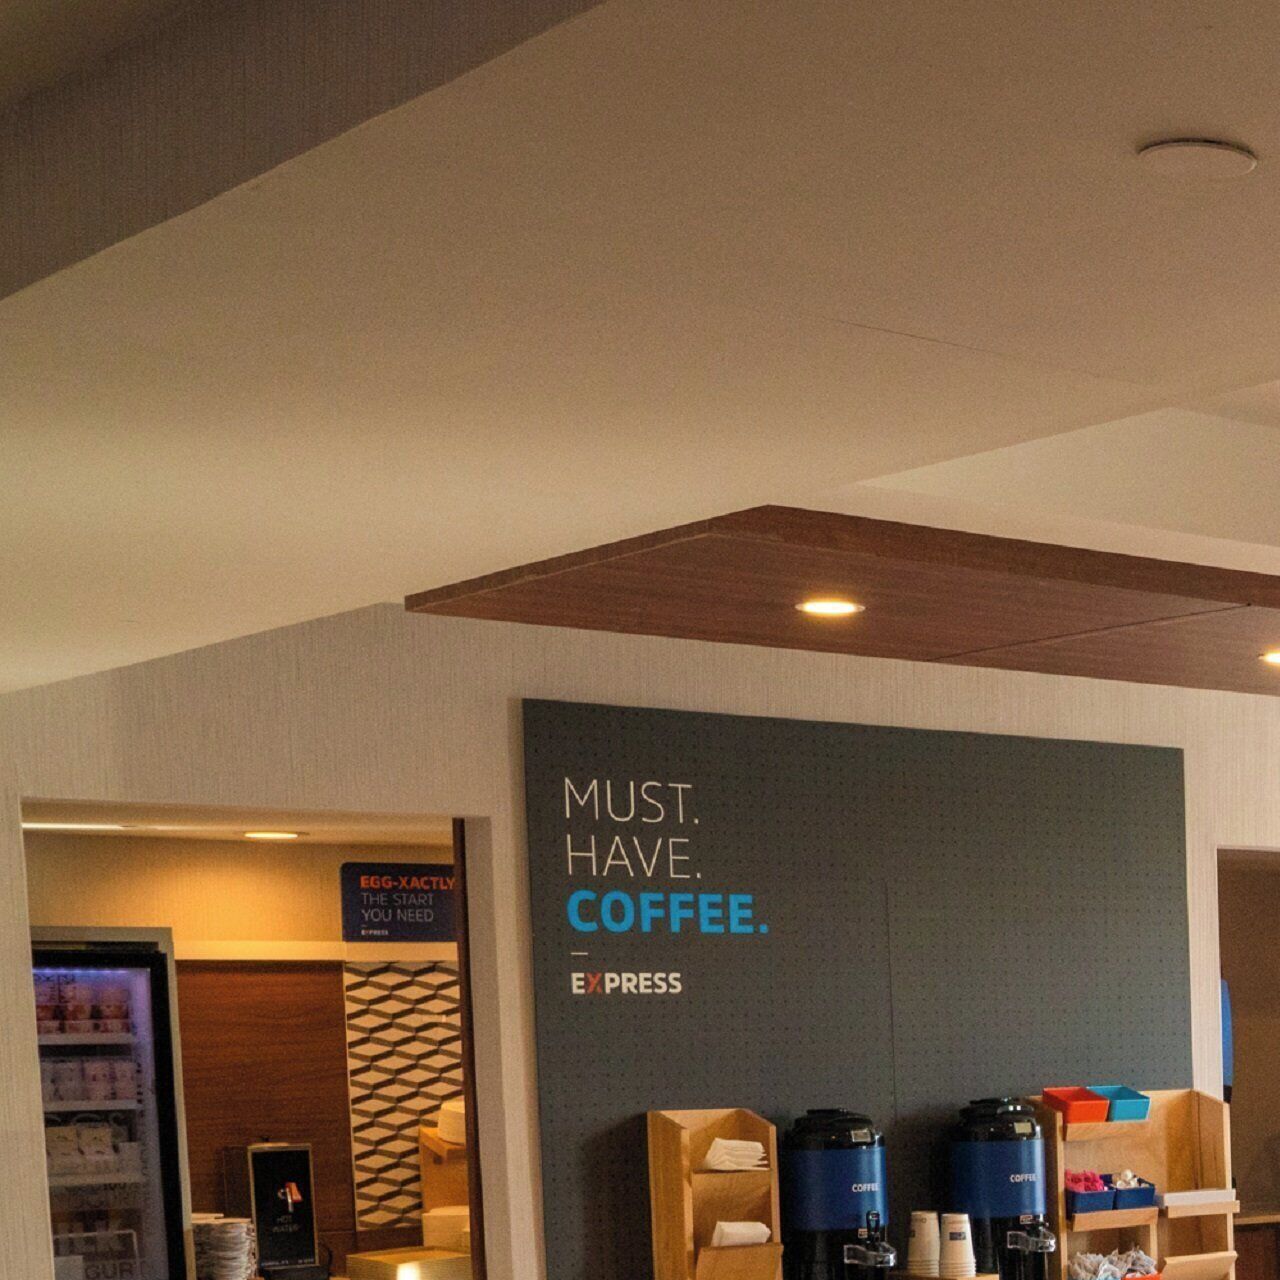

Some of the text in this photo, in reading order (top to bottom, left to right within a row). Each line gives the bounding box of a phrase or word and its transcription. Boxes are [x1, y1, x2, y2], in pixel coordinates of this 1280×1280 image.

[564, 777, 699, 824] MUST.
[566, 834, 701, 879] HAVE.
[360, 875, 455, 889] EGG-XACTLY
[361, 893, 434, 905] THE START
[361, 908, 434, 922] YOU NEED
[566, 889, 769, 934] COFFEE.
[570, 972, 683, 995] EXPRESS
